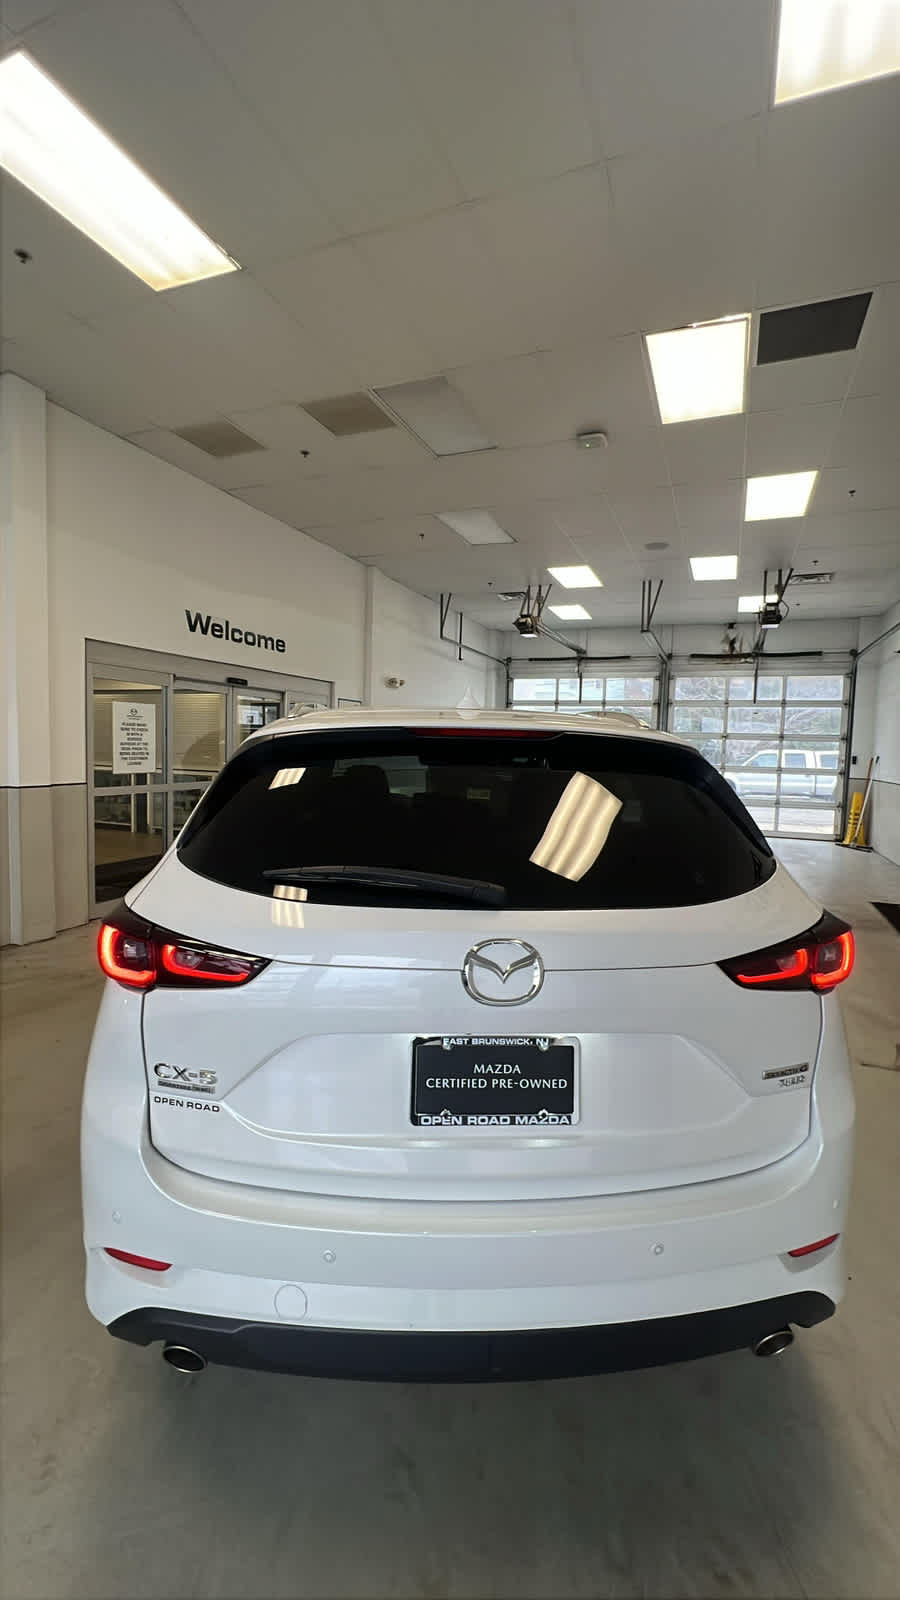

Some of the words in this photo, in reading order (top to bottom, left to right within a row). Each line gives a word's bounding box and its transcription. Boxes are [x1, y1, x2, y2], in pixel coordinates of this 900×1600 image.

[185, 609, 286, 653] Welcome
[443, 1037, 469, 1046] EAST
[536, 1037, 549, 1047] NJ
[154, 1063, 218, 1085] CX-5
[473, 1064, 522, 1074] MAZDA
[426, 1078, 488, 1089] CERTIFIED
[491, 1078, 568, 1089] PRE-OWNED
[154, 1096, 184, 1108] OPEN
[186, 1101, 220, 1113] ROAD
[420, 1115, 463, 1126] OPEN
[467, 1115, 511, 1126] ROAD
[515, 1115, 570, 1126] MAZDA
